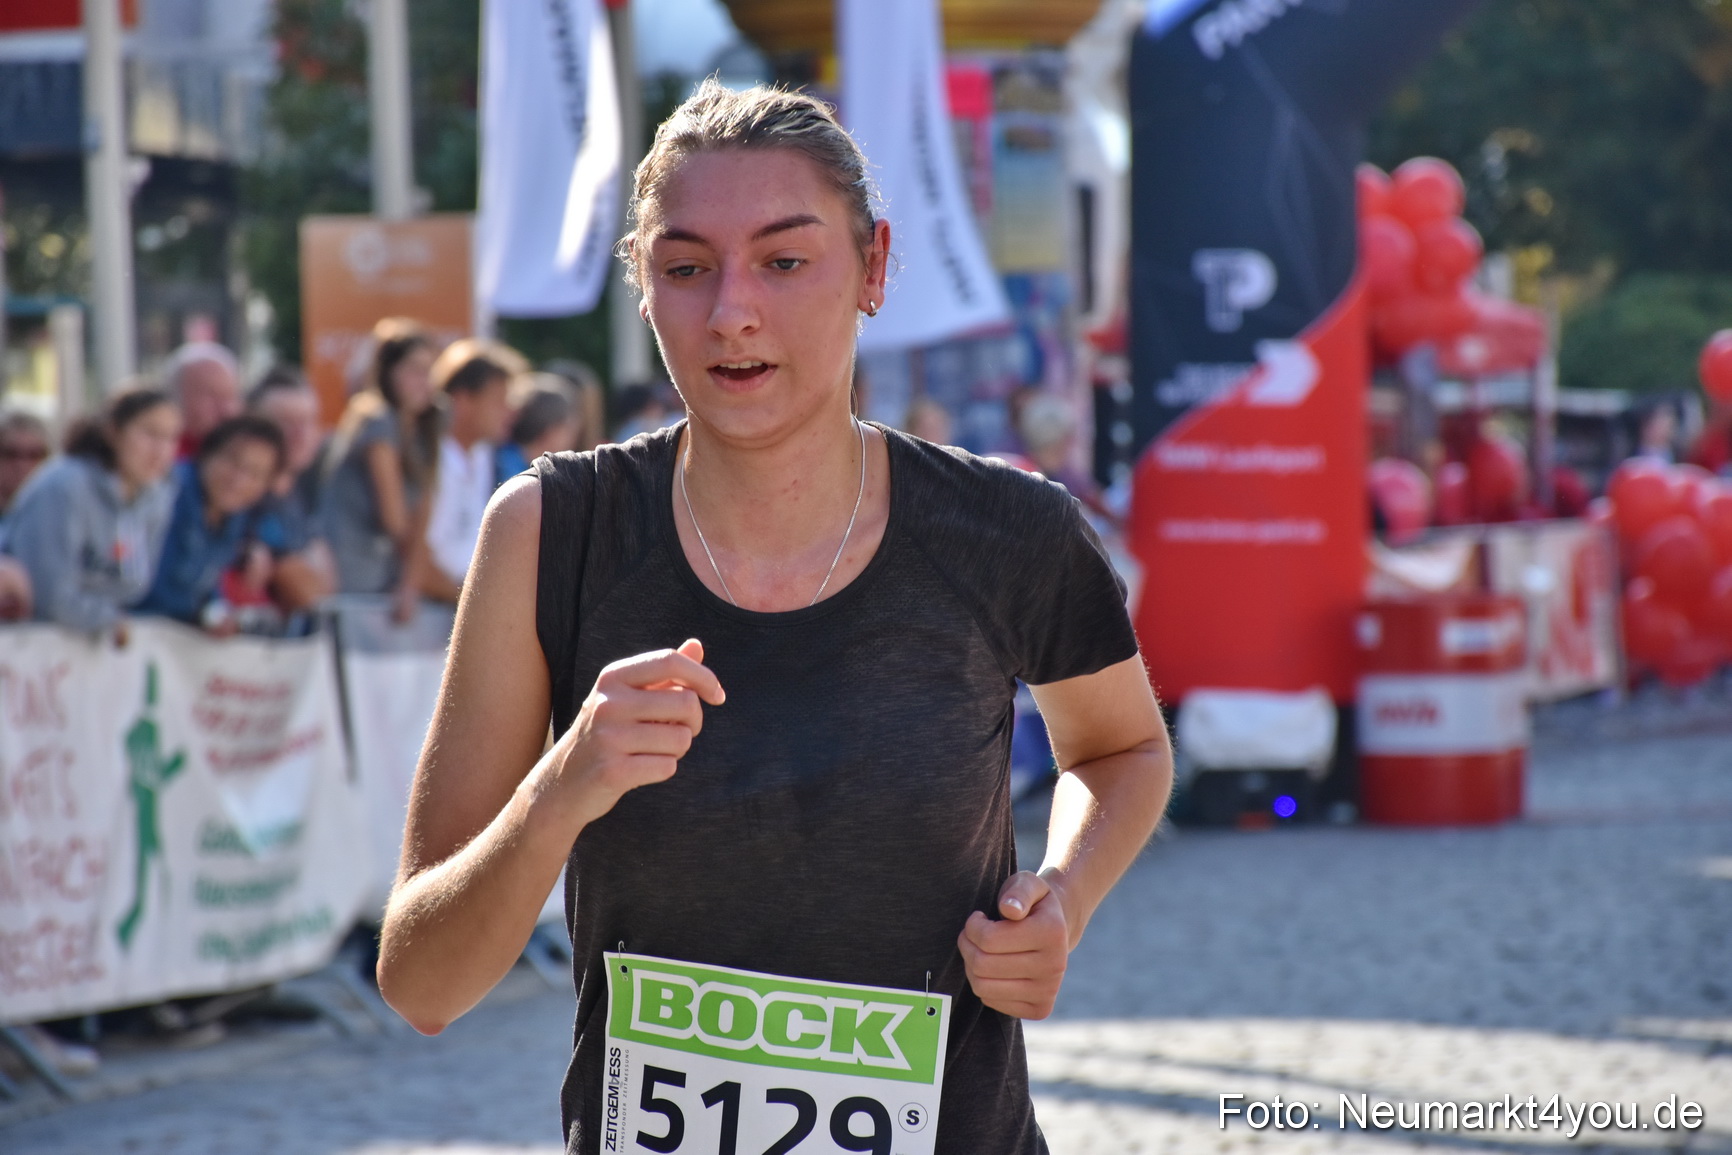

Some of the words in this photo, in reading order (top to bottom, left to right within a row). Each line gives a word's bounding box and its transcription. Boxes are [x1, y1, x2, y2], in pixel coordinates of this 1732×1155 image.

[632, 970, 912, 1069] BOCK
[636, 1064, 892, 1155] 5129
[905, 1109, 920, 1126] S
